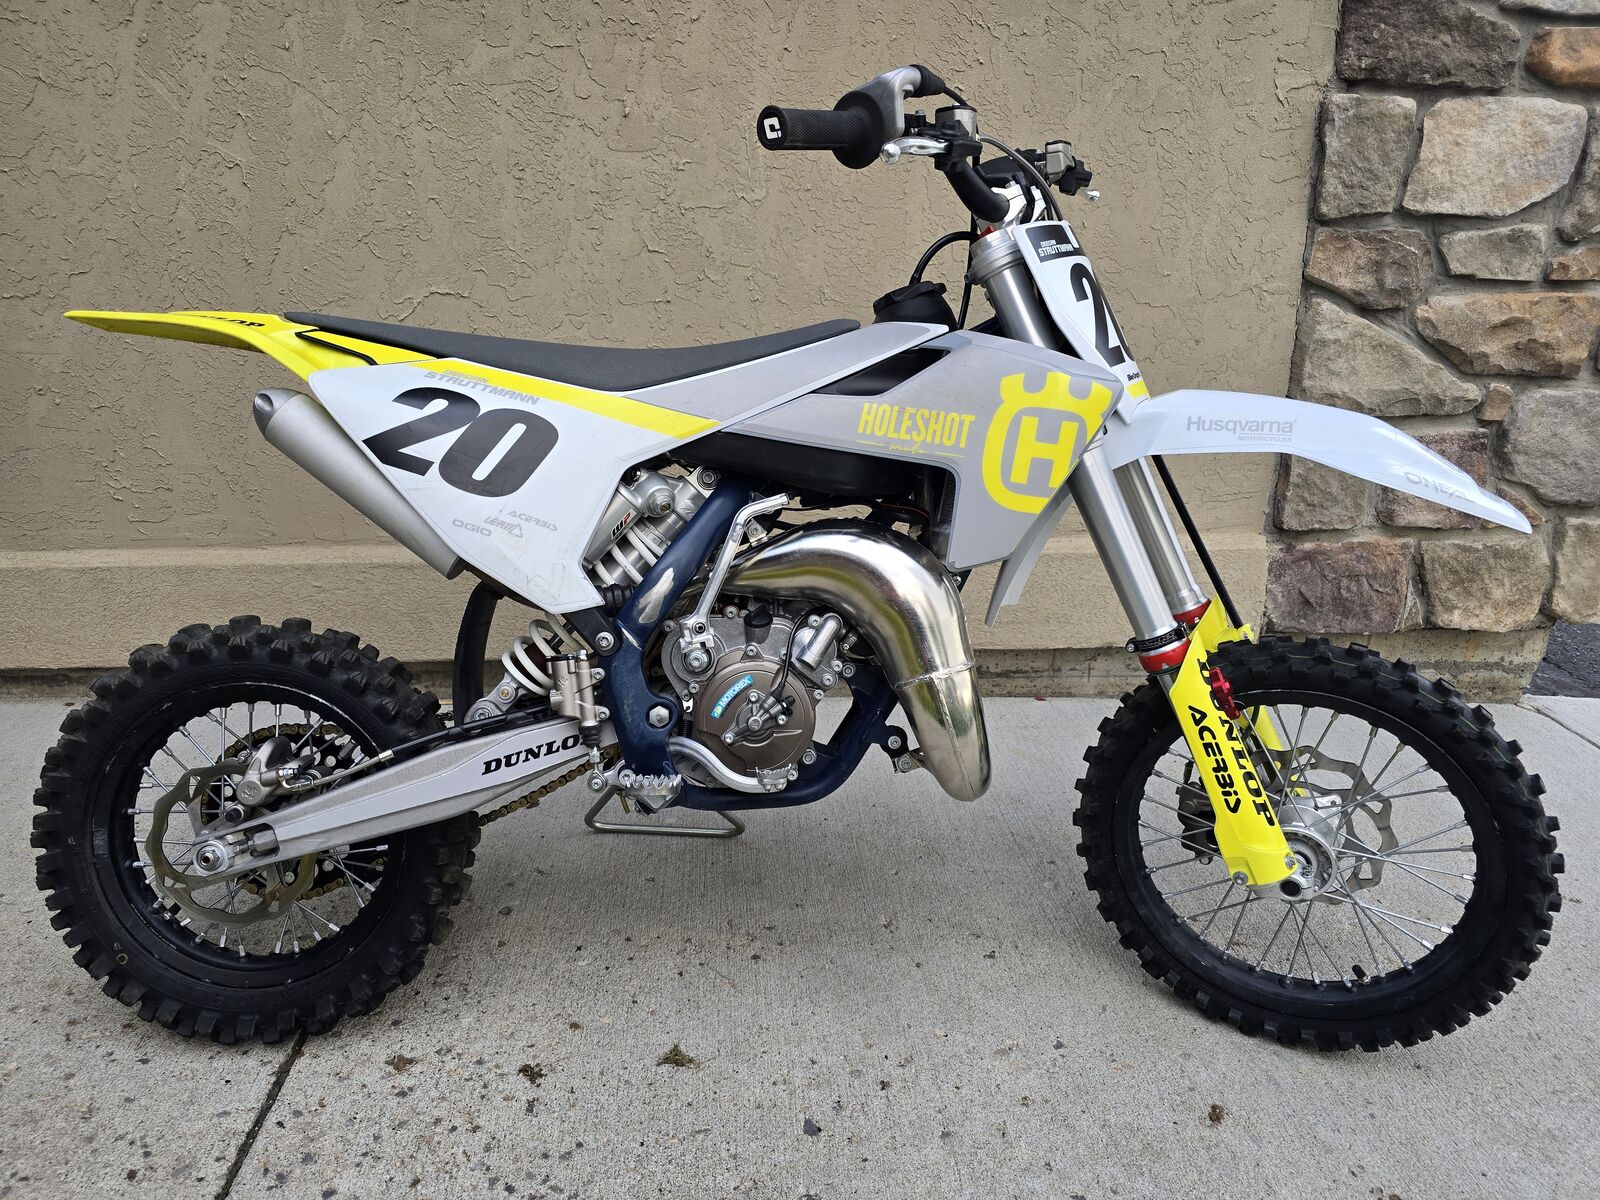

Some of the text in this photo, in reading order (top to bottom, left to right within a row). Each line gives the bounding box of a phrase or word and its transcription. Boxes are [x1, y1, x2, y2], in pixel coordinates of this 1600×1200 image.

[424, 371, 540, 405] STRUTTMANN
[857, 402, 976, 449] HOLESHOT
[1186, 416, 1294, 434] Husqvarna
[1238, 435, 1293, 443] MOTORCYCLES
[362, 387, 559, 497] 20
[452, 518, 492, 536] OGIO
[719, 676, 752, 707] MOTOREX
[482, 733, 584, 775] DUNLO
